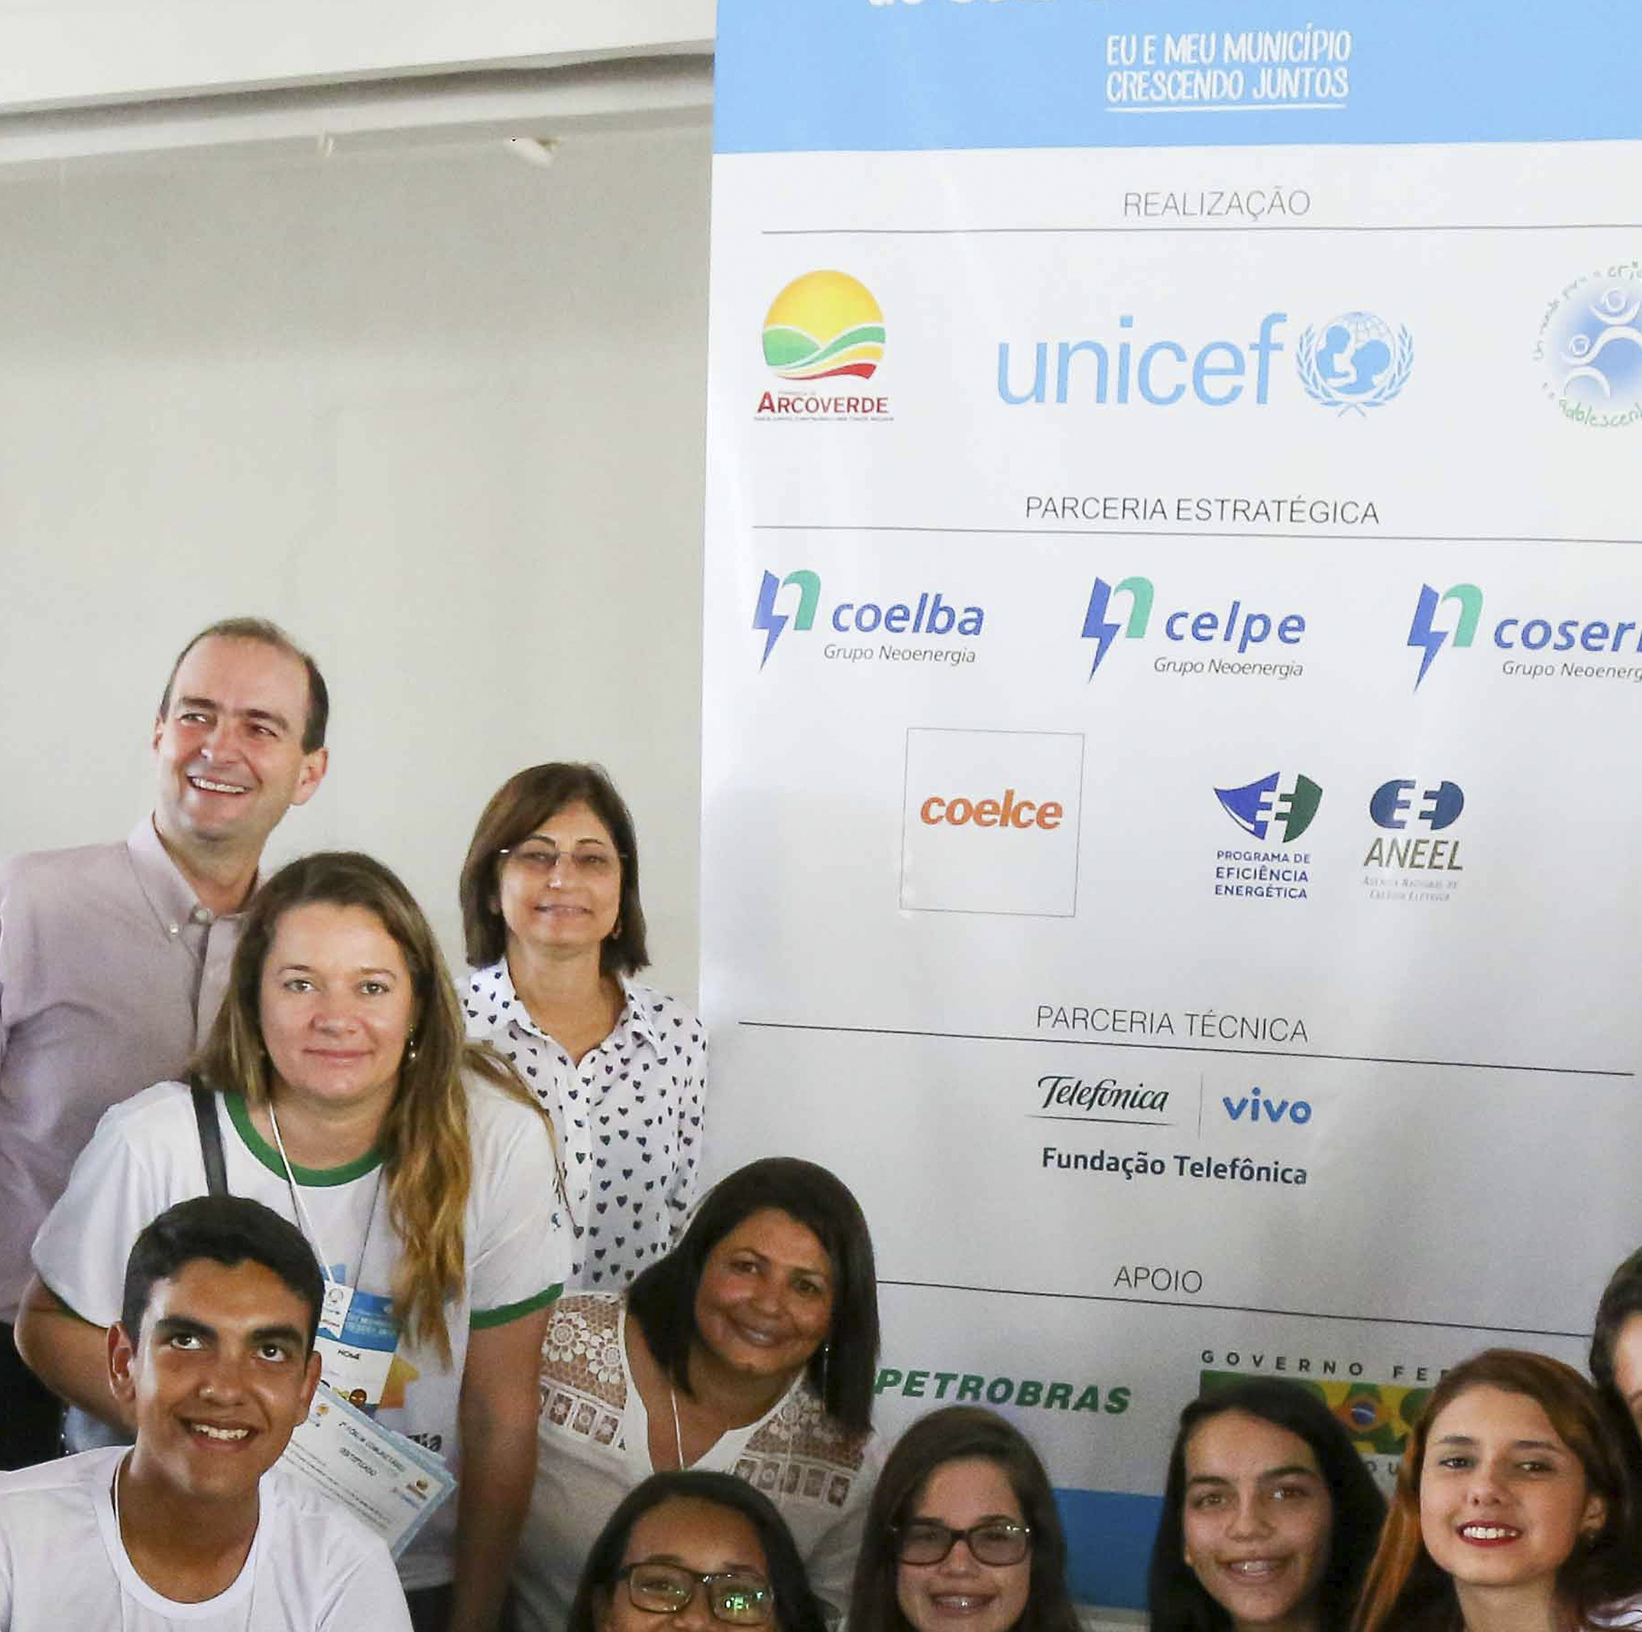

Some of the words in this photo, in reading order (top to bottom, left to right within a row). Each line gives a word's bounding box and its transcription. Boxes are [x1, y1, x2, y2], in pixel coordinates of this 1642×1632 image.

[1106, 34, 1137, 66] EU
[1143, 35, 1156, 65] E
[1164, 33, 1216, 65] MEU
[1223, 22, 1352, 64] MUNICÍPIO
[1106, 69, 1244, 103] CRESCENDO
[1252, 67, 1350, 100] JUNTOS
[1123, 186, 1311, 222] REALIZAÇÃO
[997, 312, 1288, 406] unicef
[756, 390, 890, 414] ARCOVERDE
[1026, 496, 1168, 522] PARCERIA
[1175, 494, 1380, 526] ESTRATÉGICA
[831, 593, 986, 637] coelba
[1165, 601, 1306, 655] celpe
[823, 643, 875, 664] Grupo
[878, 645, 977, 667] Neoenergia
[1154, 657, 1205, 677] Grupo
[1208, 658, 1305, 680] Neoenergia
[1501, 660, 1556, 680] Grupo
[920, 789, 1064, 832] coelce
[1216, 850, 1289, 864] PROGRAMA
[1293, 853, 1312, 865] DE
[1363, 837, 1464, 871] ANEEL
[1214, 881, 1307, 900] ENERGÉTICA
[1215, 865, 1309, 882] EFICIÊNCIA
[1036, 1005, 1175, 1035] PARCERIA
[1185, 1009, 1308, 1043] TÉCNICA
[1222, 1087, 1312, 1124] vivo
[1042, 1147, 1166, 1180] Fundação
[1173, 1155, 1308, 1185] Telefônica
[1113, 1265, 1203, 1294] APOIO
[1201, 1350, 1364, 1377] GOVERNO
[874, 1368, 1132, 1415] PETROBRAS
